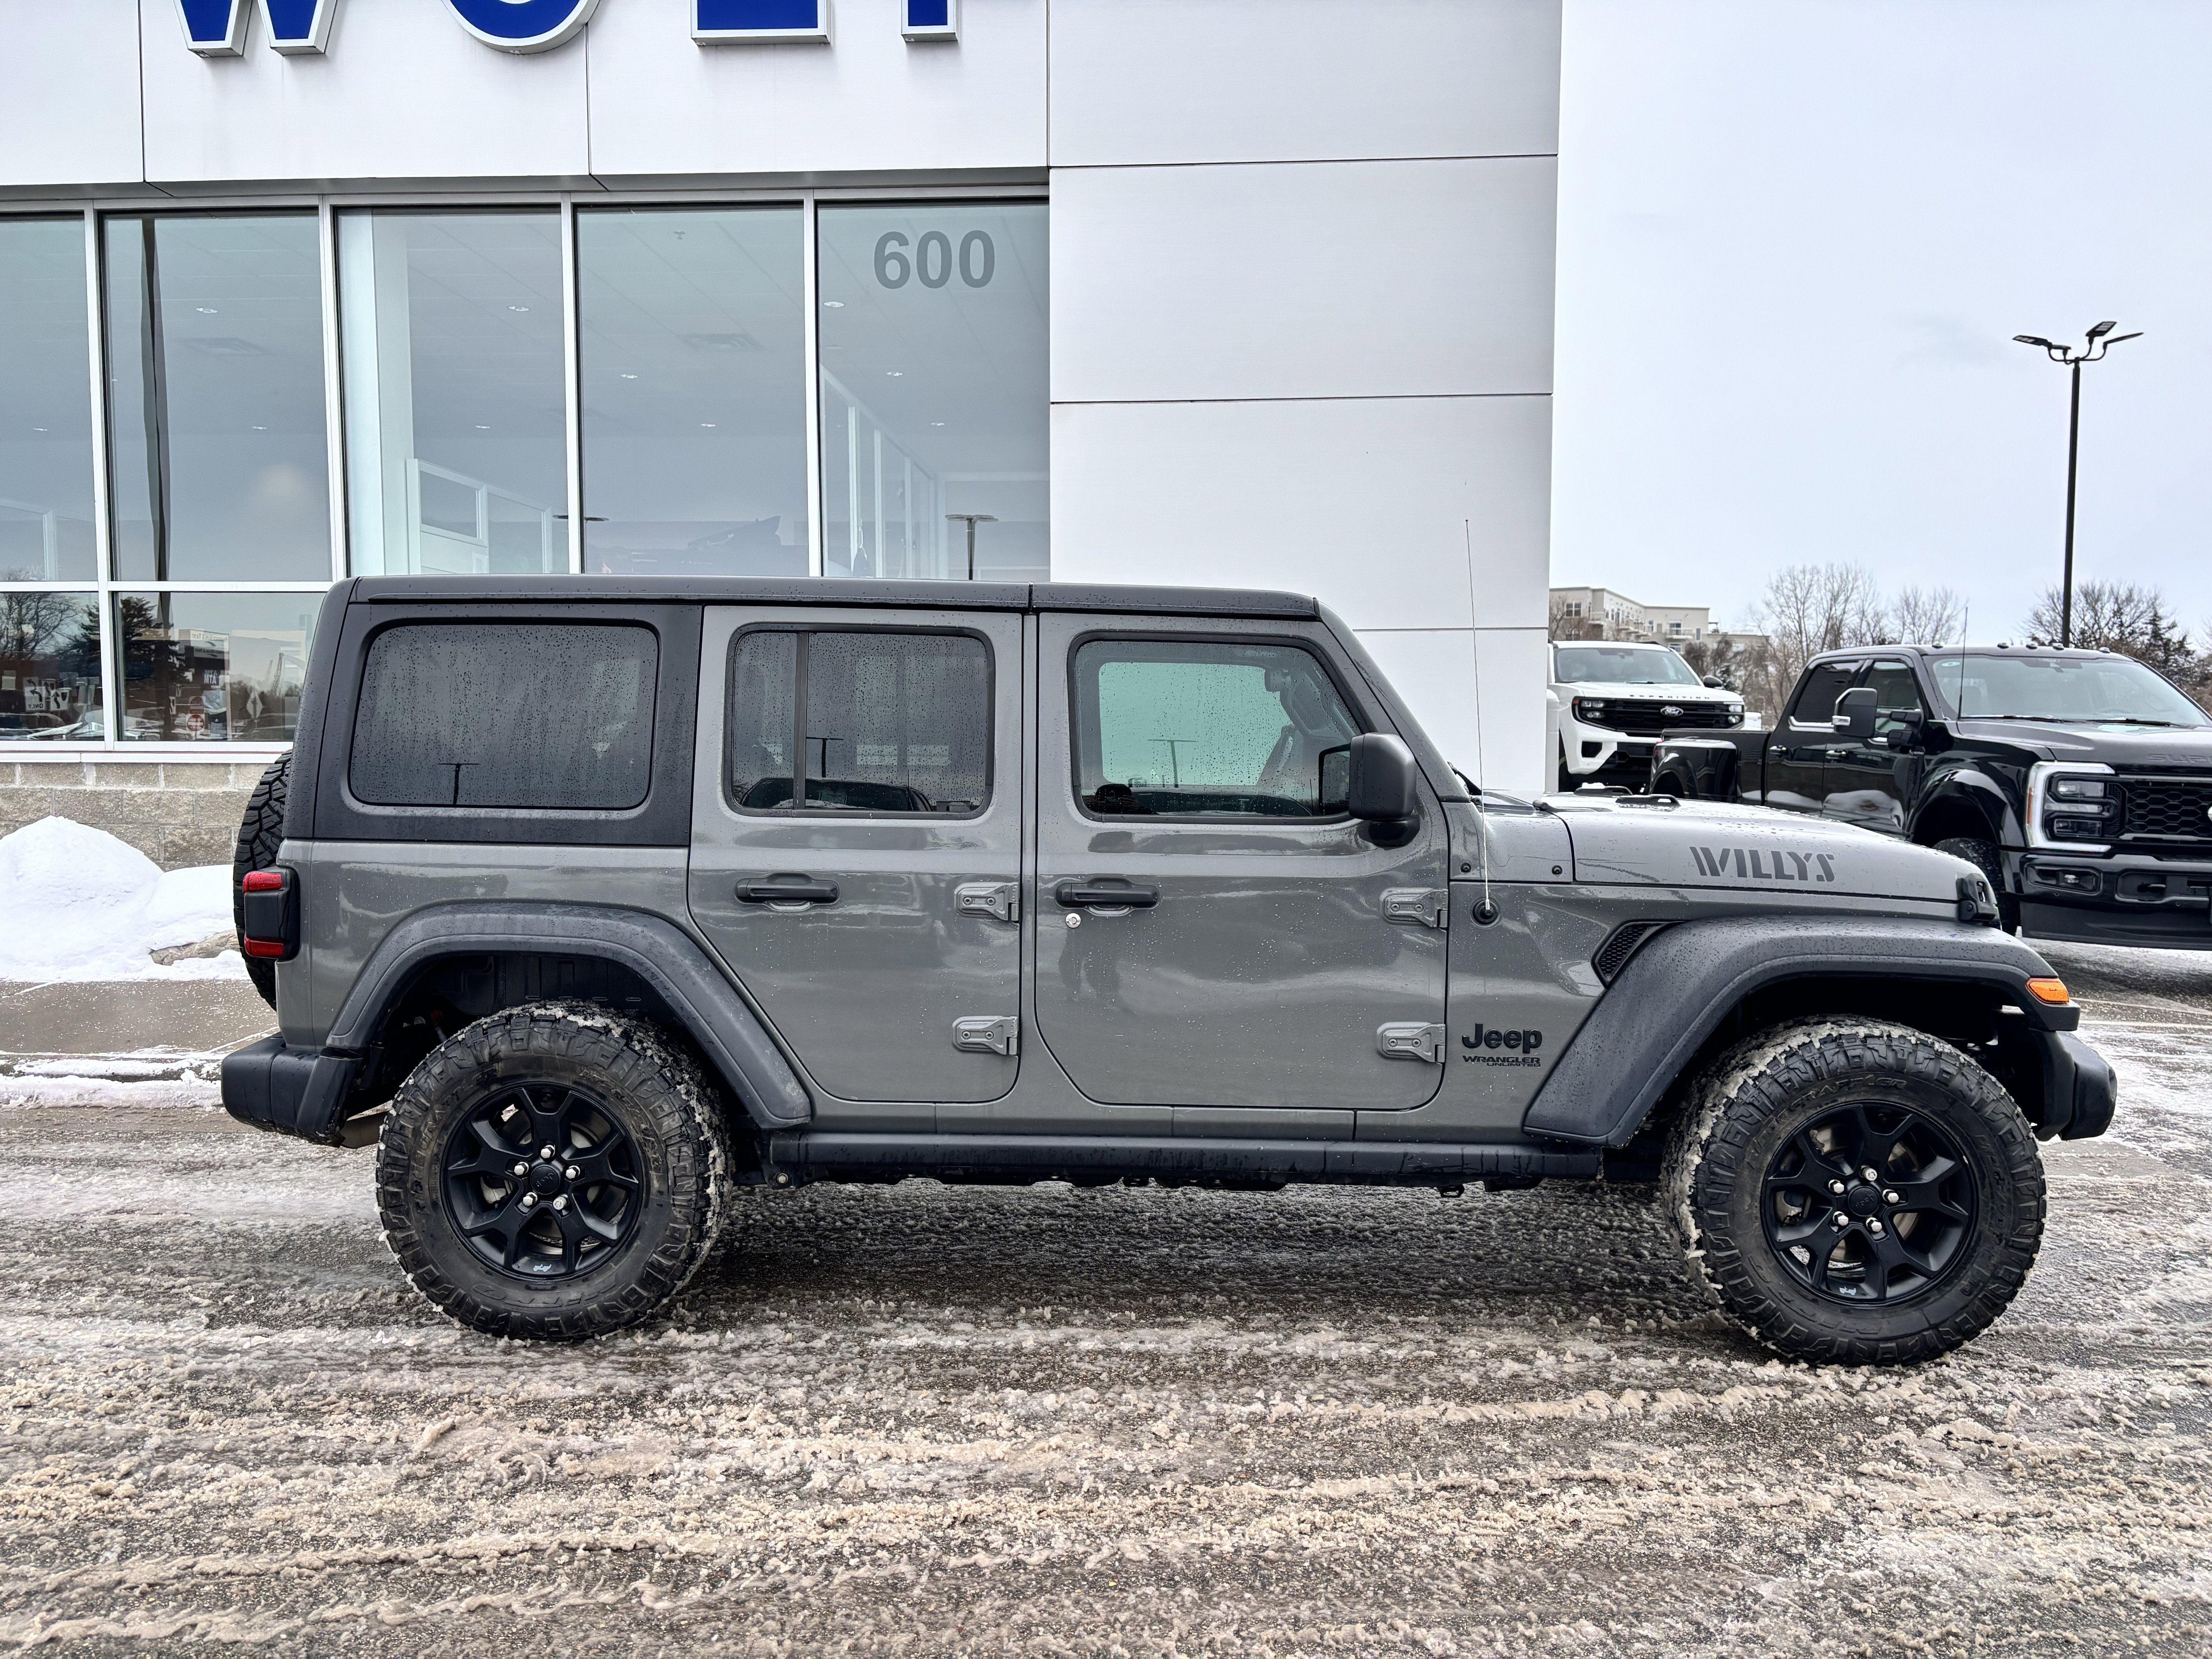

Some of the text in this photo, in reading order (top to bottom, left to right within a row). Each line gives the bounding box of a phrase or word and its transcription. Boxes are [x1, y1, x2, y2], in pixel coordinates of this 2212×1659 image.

[874, 230, 995, 289] 600
[2147, 754, 2212, 764] SUP
[1689, 847, 1835, 882] WILLYS
[1462, 1022, 1542, 1054] Jeep
